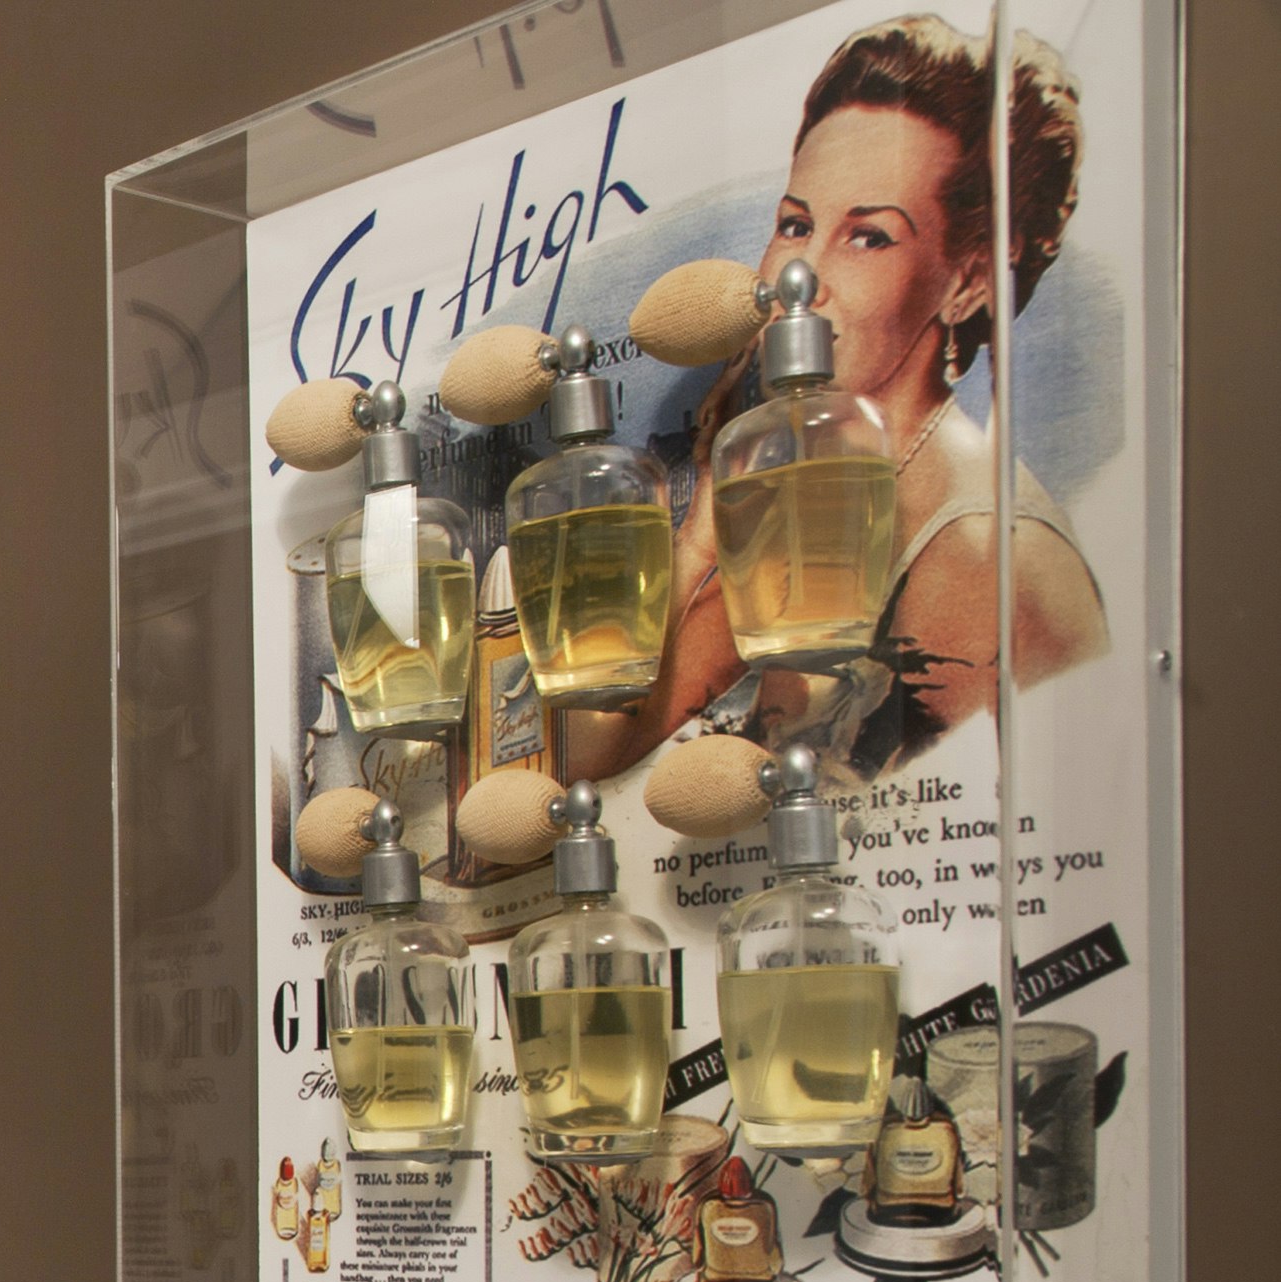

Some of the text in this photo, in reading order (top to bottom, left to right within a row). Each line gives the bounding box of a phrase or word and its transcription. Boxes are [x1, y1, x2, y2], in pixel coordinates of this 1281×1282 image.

[440, 96, 650, 339] High
[870, 784, 911, 812] it's
[917, 777, 963, 804] like
[849, 818, 929, 859] you've
[653, 841, 768, 877] no perfum
[877, 850, 1103, 889] too, in wys you
[902, 899, 956, 932] only
[355, 1172, 452, 1188] TRIAL SIZES 2/6
[356, 1198, 452, 1210] You can make your first
[410, 1211, 428, 1221] with
[431, 1211, 450, 1221] these
[435, 1224, 477, 1236] fragrances
[356, 1238, 387, 1248] through
[389, 1237, 402, 1246] the
[449, 1237, 467, 1246] trial
[378, 1249, 406, 1260] Always
[409, 1250, 430, 1260] carry
[432, 1251, 446, 1259] one
[449, 1249, 458, 1259] of
[340, 1261, 359, 1270] these
[401, 1263, 425, 1273] phials
[428, 1263, 436, 1272] in
[439, 1264, 458, 1273] your
